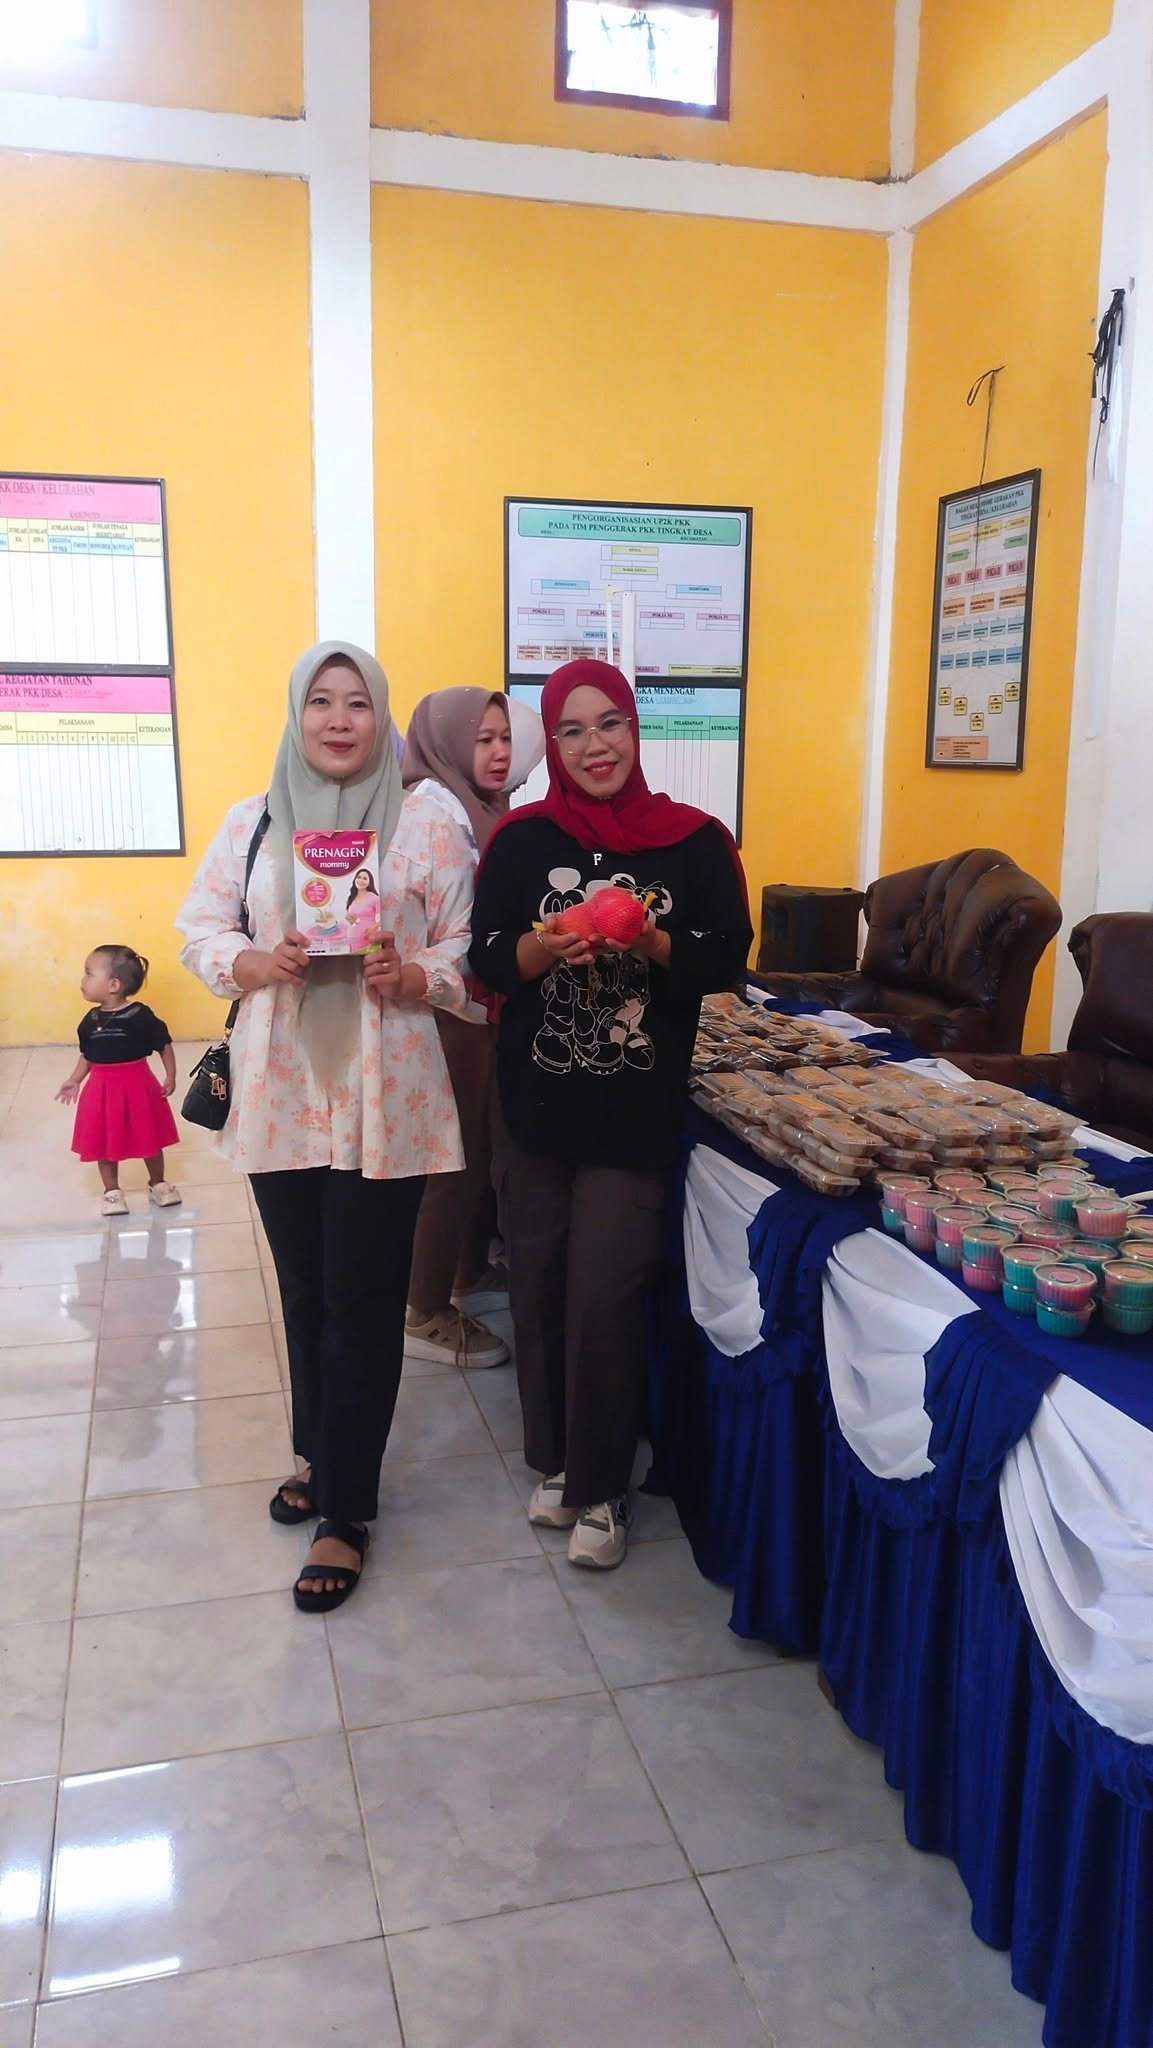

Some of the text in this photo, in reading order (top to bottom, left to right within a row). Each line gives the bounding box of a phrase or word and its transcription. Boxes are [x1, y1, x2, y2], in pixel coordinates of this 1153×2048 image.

[13, 481, 35, 494] DESA
[42, 483, 96, 496] KELURAHAN
[572, 514, 691, 527] PENGORGANISASIAN UP2K PKK
[548, 522, 571, 530] PADA
[572, 523, 588, 531] TIM
[588, 524, 638, 533] PENGGERAK
[639, 526, 656, 534] PKK
[657, 527, 692, 536] TINGKAT
[6, 676, 50, 685] KEGIATAN
[53, 676, 93, 686] TAHUNAN
[23, 688, 40, 698] PKK
[41, 688, 64, 698] DESA
[654, 688, 696, 696] MENENGAH
[636, 696, 654, 704] DESA
[304, 848, 365, 858] PRENAGEN
[593, 853, 603, 866] F
[320, 860, 350, 870] mommy
